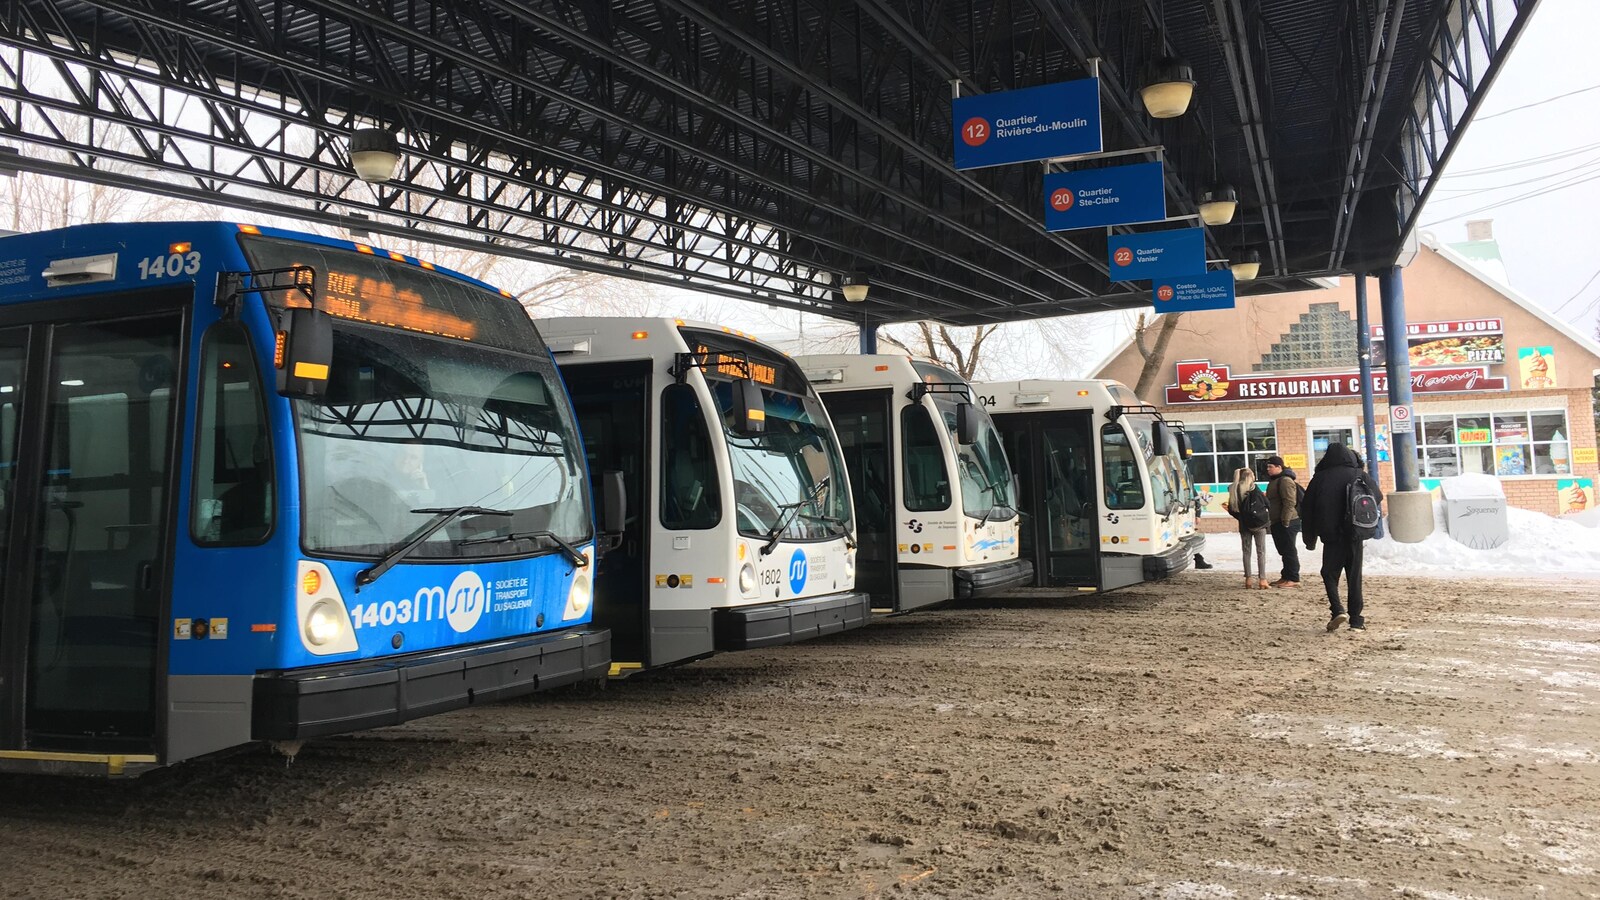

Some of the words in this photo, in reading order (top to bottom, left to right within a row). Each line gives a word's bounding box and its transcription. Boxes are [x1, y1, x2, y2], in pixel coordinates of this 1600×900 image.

[996, 115, 1038, 128] Quartier
[966, 124, 985, 139] 12
[996, 119, 1088, 138] Rivière-du-Moulin
[1078, 187, 1112, 197] Quartier
[1054, 193, 1070, 205] 20
[1079, 196, 1120, 207] Ste-Claire
[1117, 251, 1130, 262] 22
[1136, 247, 1164, 255] Quartier
[138, 251, 202, 280] 1403
[1136, 255, 1158, 263] Vanier
[326, 271, 358, 296] RUE
[1158, 289, 1172, 297] 175
[1427, 323, 1449, 333] DU
[1456, 320, 1498, 332] JOUR
[1467, 349, 1503, 361] PIZZA
[1239, 379, 1342, 397] RESTAURANT
[1349, 377, 1389, 392] CEZ
[495, 577, 520, 590] SOCIÉTÉ
[520, 577, 529, 587] DE
[760, 568, 782, 586] 1802
[495, 588, 529, 601] TRANSPORT
[494, 603, 503, 612] DU
[503, 598, 533, 611] SAGUENAY
[351, 599, 412, 630] 1403
